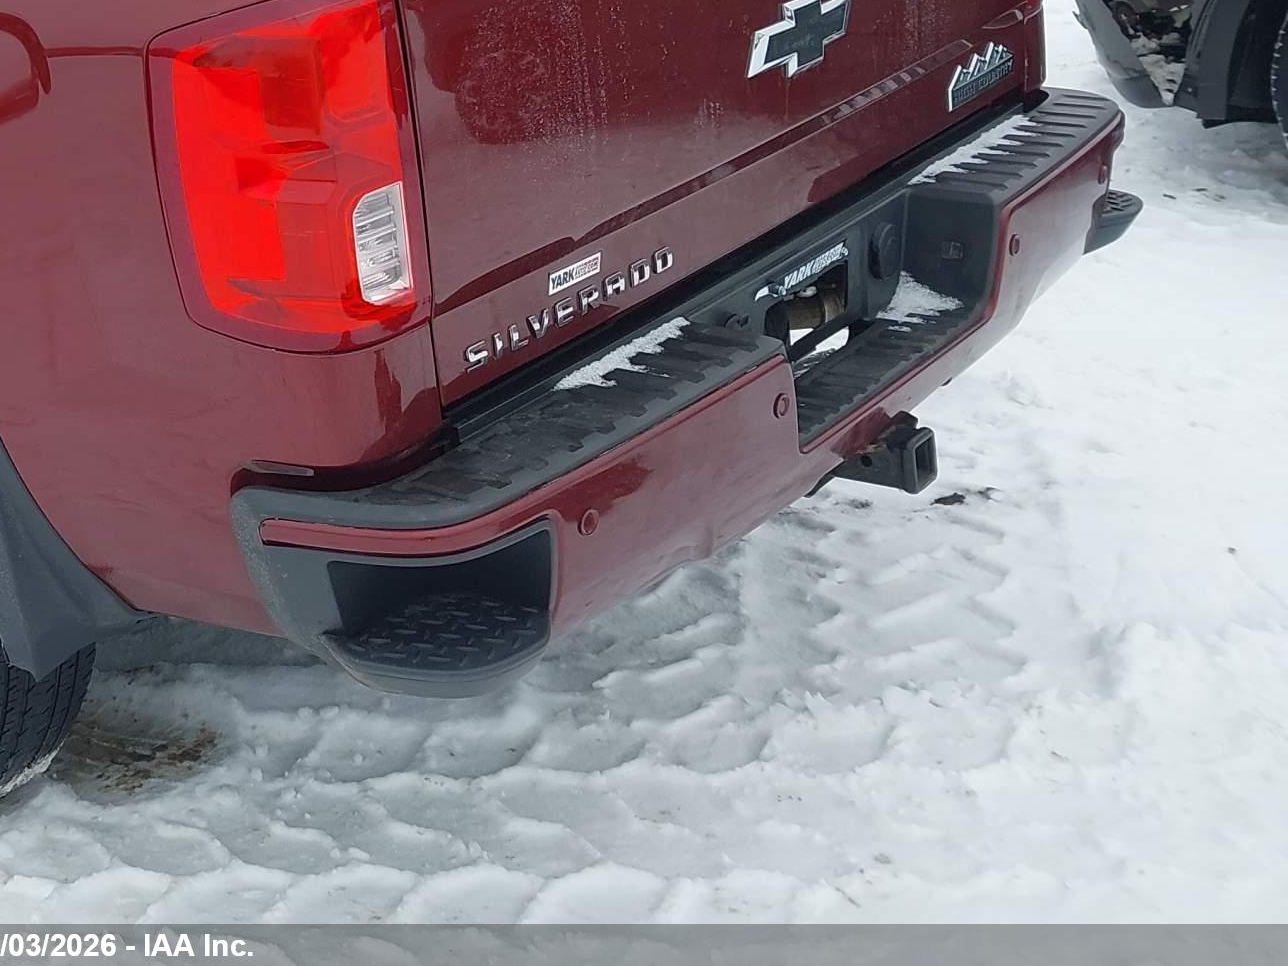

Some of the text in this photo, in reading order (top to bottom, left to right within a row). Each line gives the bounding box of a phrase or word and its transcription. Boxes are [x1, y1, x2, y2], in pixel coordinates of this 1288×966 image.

[551, 267, 575, 290] YARK
[783, 259, 815, 289] YARK
[464, 246, 674, 373] SILVERADO
